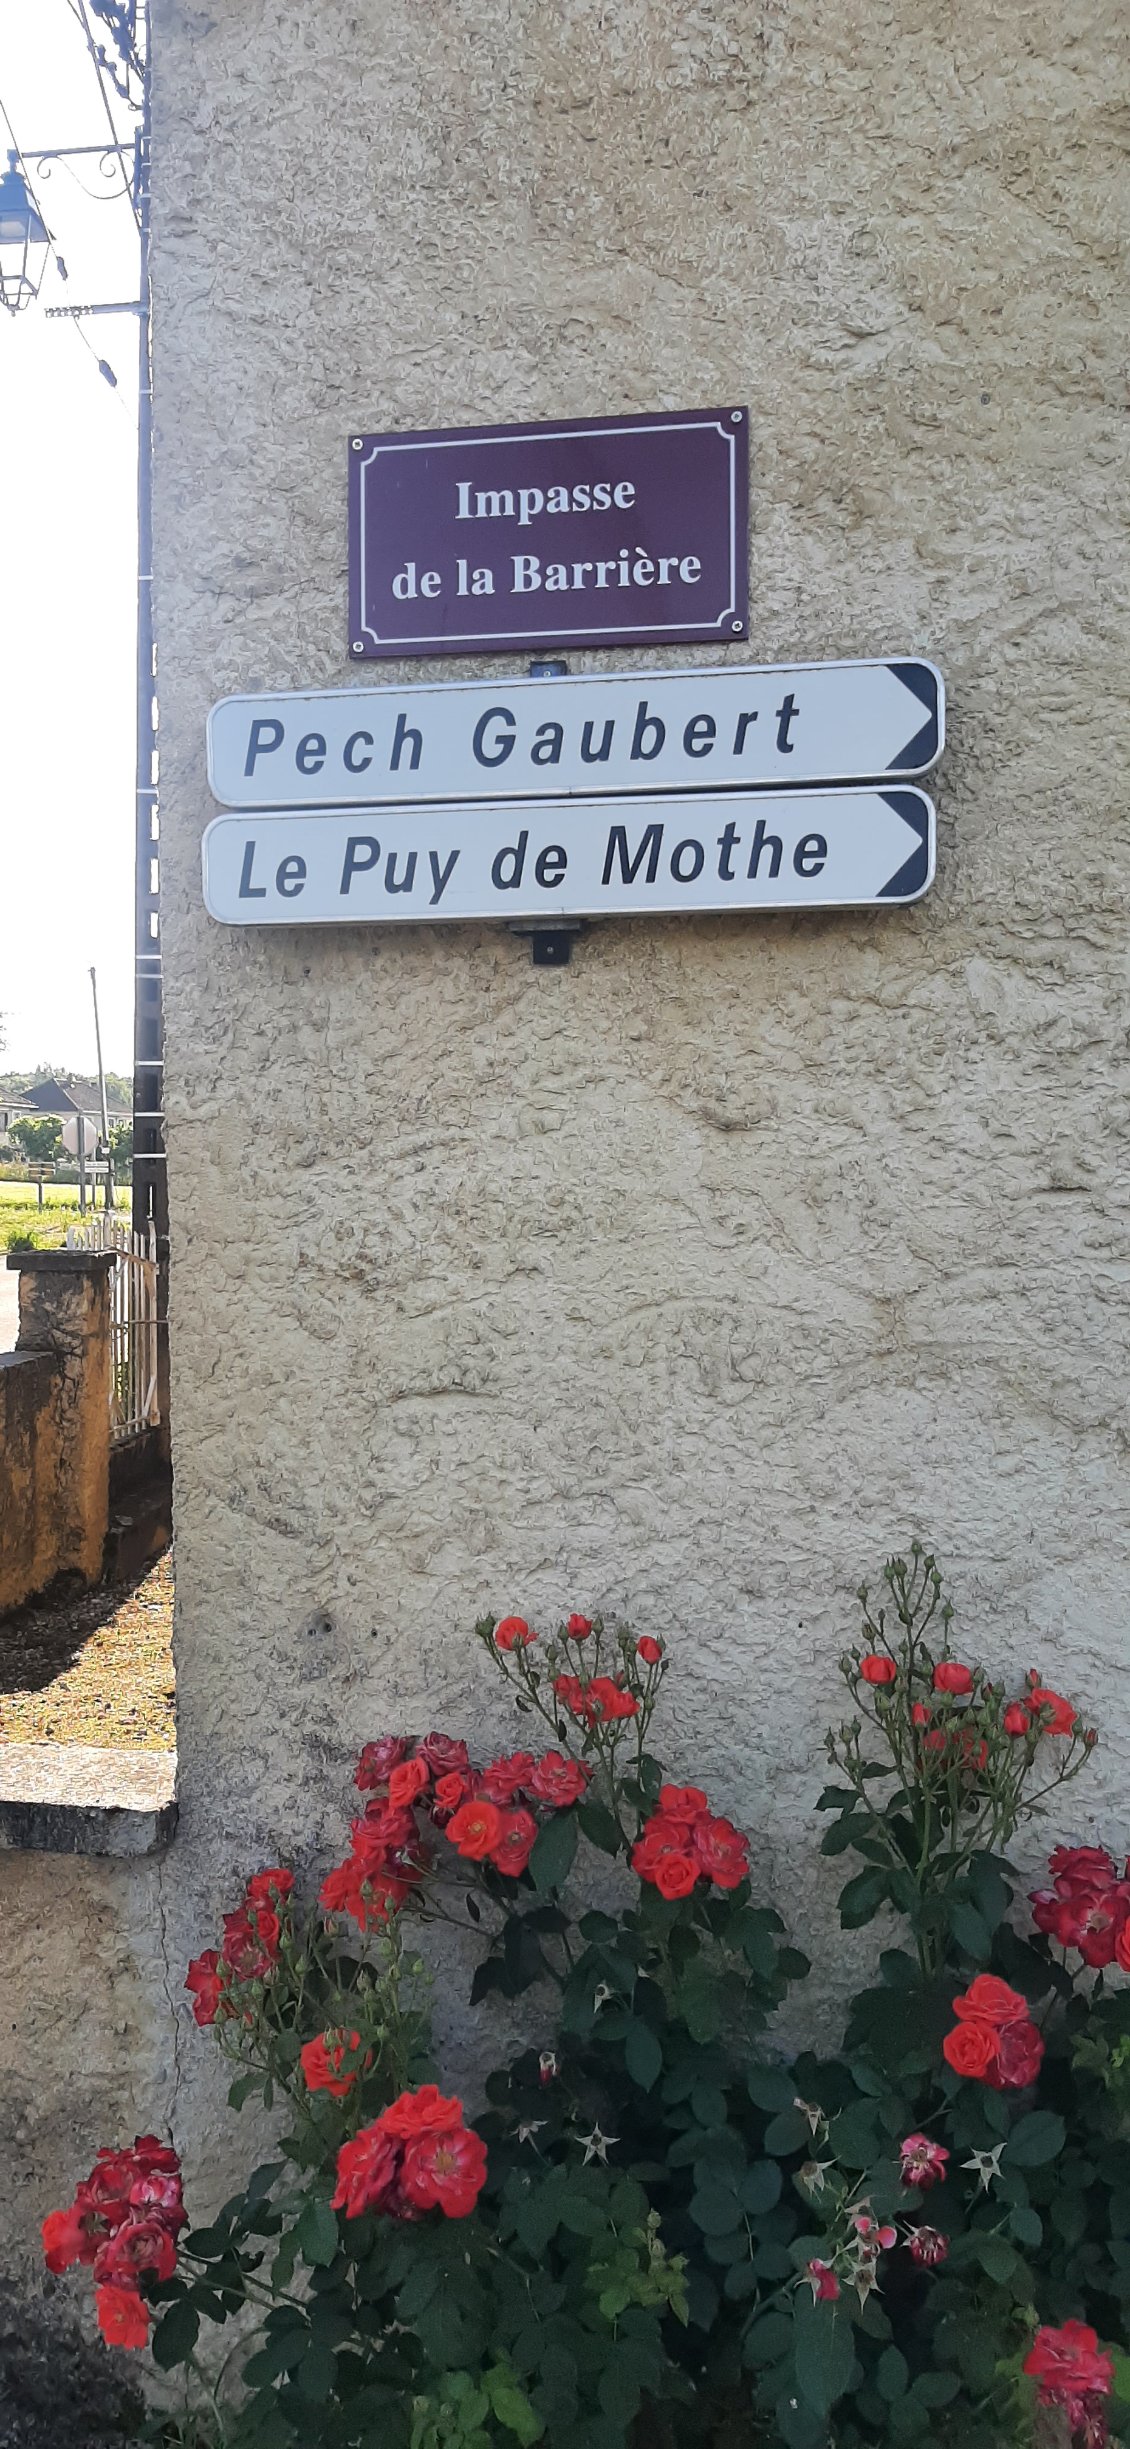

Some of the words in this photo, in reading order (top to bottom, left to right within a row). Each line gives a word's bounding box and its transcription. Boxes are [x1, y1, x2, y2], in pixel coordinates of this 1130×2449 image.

[455, 480, 635, 525] Impasse
[392, 562, 441, 599] de
[456, 559, 495, 596] la
[510, 547, 702, 593] Barrière
[244, 713, 423, 776] Pech
[473, 694, 800, 768] Gaubert
[239, 840, 307, 898] Le
[340, 836, 461, 904] Puy
[492, 831, 568, 890] de
[602, 820, 828, 885] Mothe
